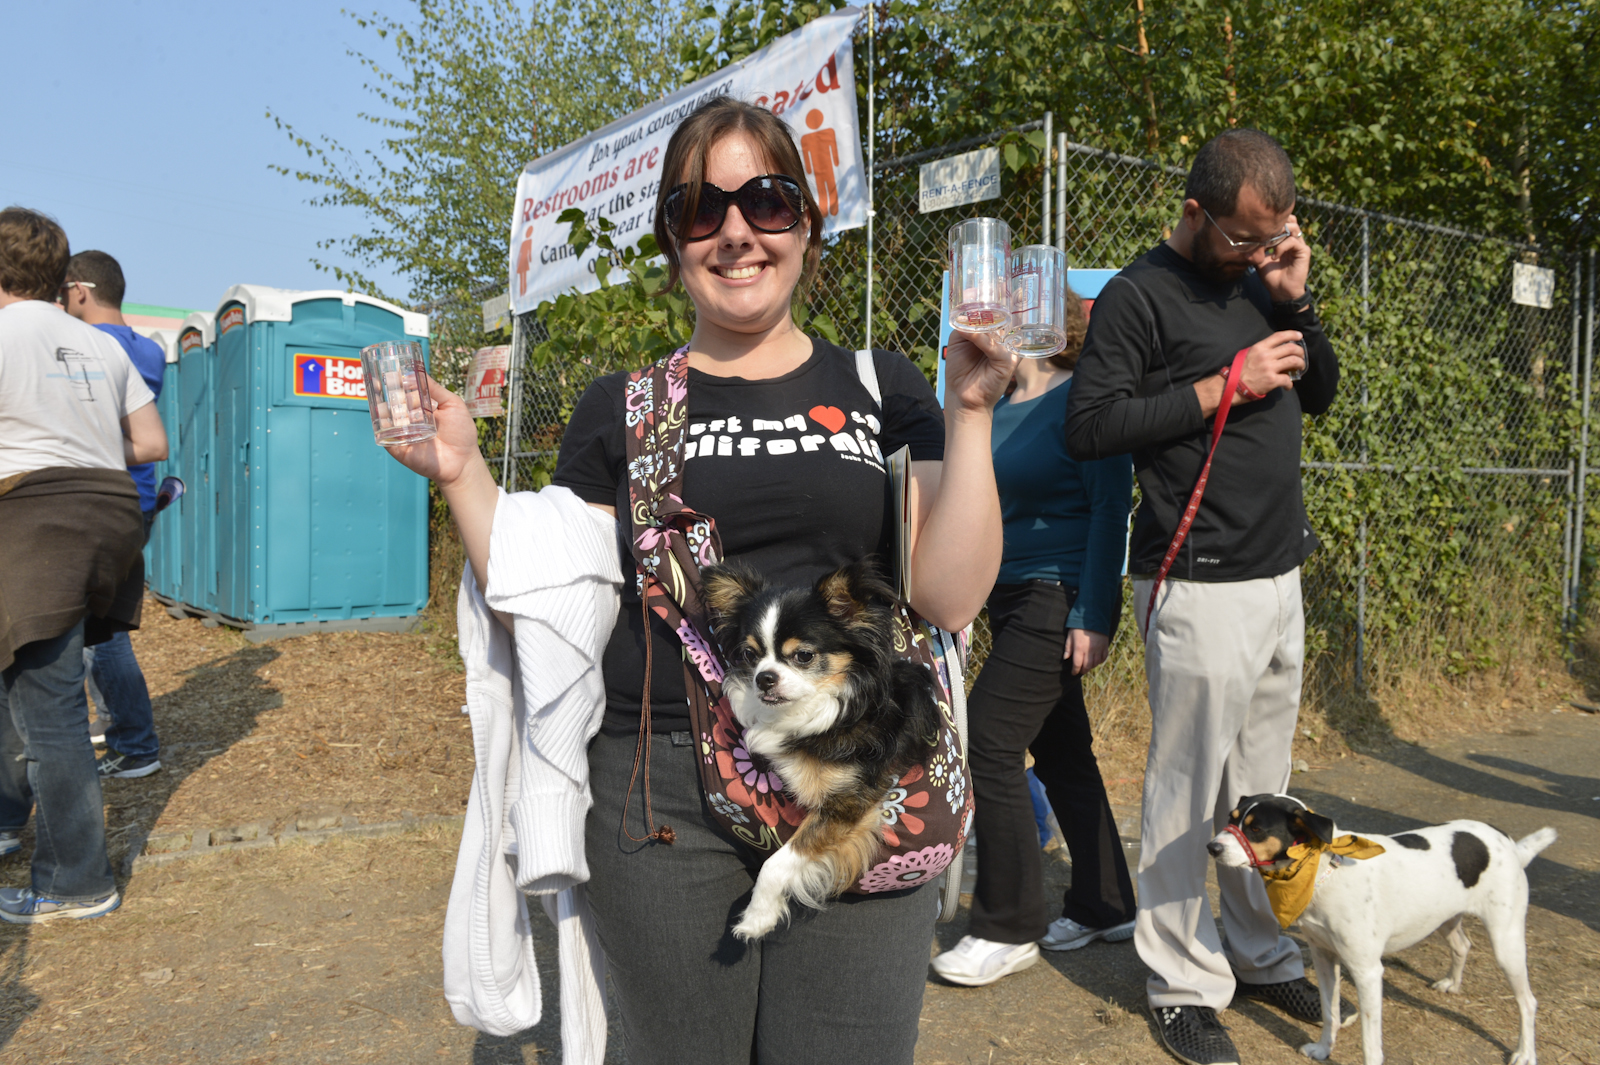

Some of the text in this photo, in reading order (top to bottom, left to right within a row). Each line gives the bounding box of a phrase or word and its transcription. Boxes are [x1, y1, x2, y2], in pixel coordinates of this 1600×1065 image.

[588, 143, 610, 172] for
[613, 126, 643, 160] your
[521, 165, 621, 224] Restrooms
[624, 145, 659, 182] are
[921, 174, 998, 200] RENT-A-FENCE
[608, 190, 636, 216] the
[638, 180, 661, 203] sta
[325, 358, 365, 380] Hon
[326, 377, 367, 397] Buc
[481, 384, 501, 398] NITE
[689, 411, 881, 436] eft my in
[684, 428, 885, 466] alifornia
